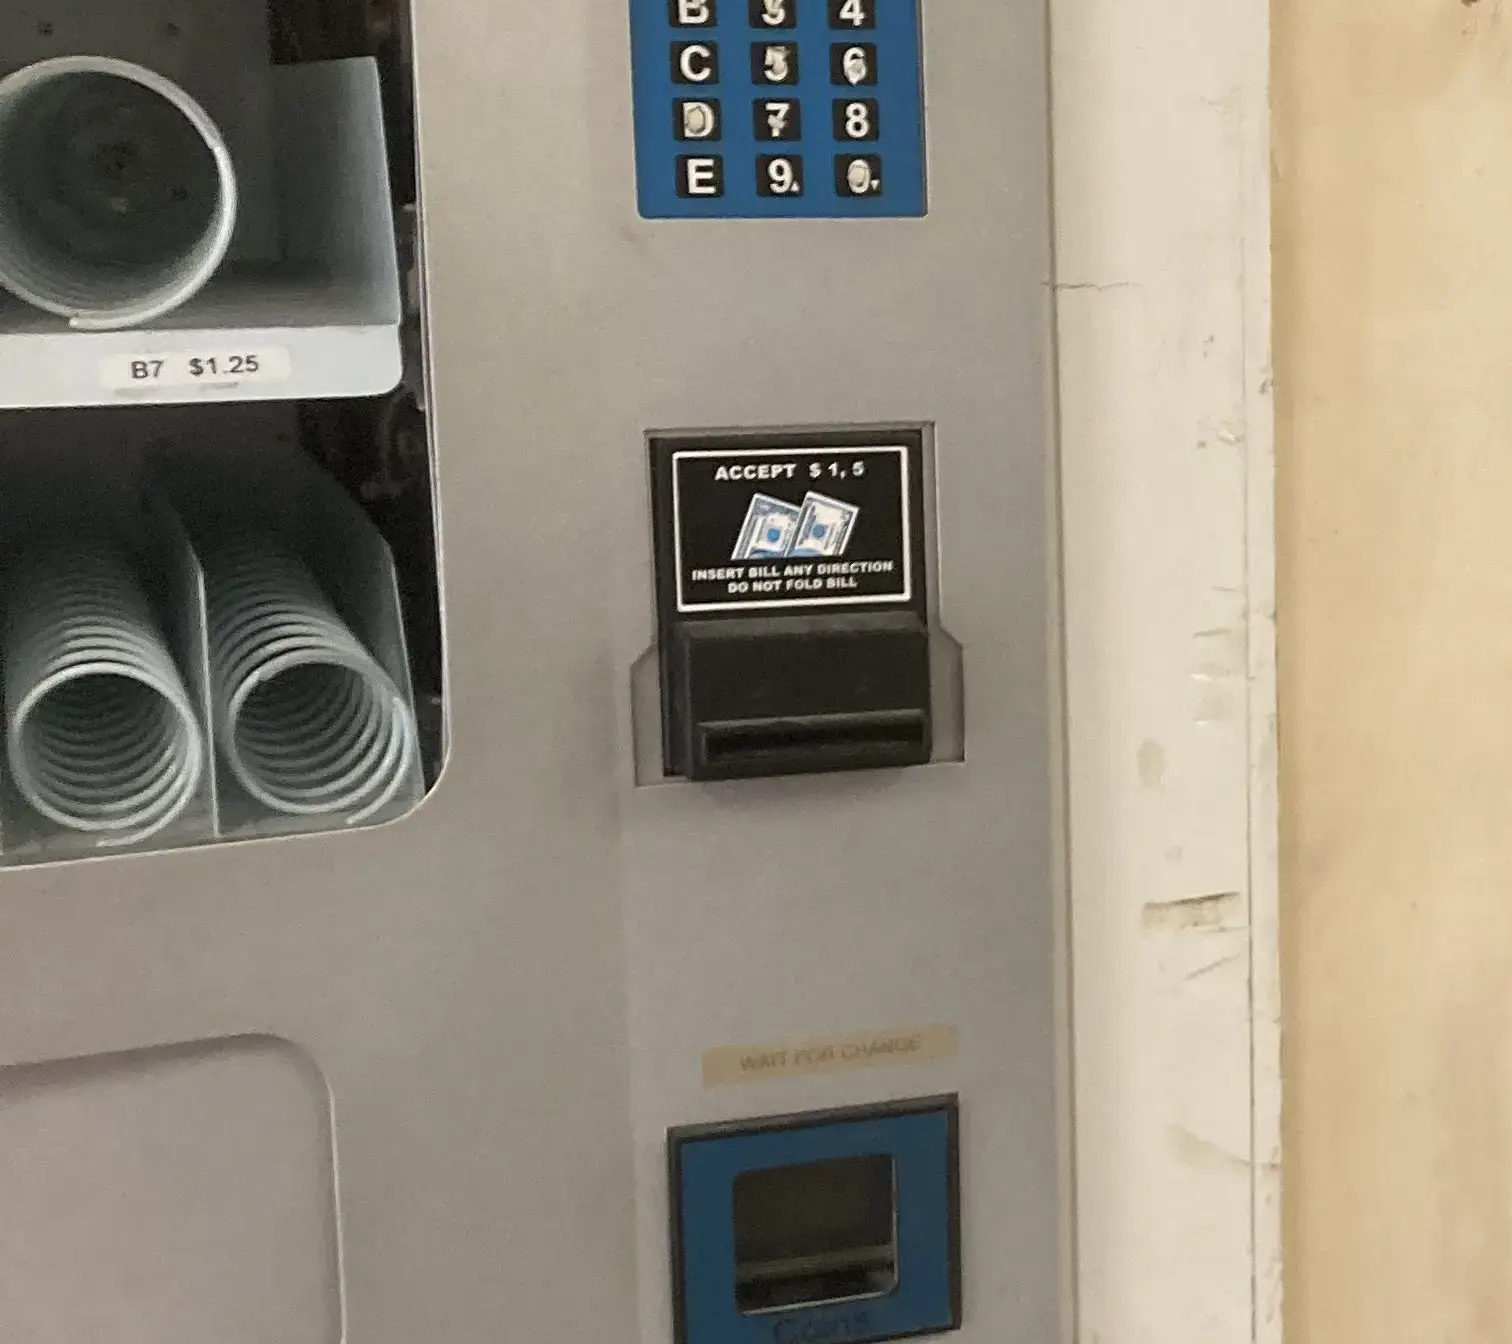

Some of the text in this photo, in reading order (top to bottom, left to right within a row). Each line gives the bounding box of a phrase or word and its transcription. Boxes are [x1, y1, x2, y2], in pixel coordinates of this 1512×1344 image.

[679, 44, 712, 82] C
[842, 46, 868, 85] 6
[682, 101, 871, 139] D 7 8
[686, 158, 717, 195] E
[767, 157, 795, 195] 9
[130, 353, 261, 380] B7 $1.25
[714, 462, 797, 481] ACCEPT
[691, 559, 893, 581] INSERT BILL ANY DIRECTION
[728, 576, 858, 595] DO NOT FOLD BILL
[739, 1032, 923, 1072] WAIT FOR CHANGE
